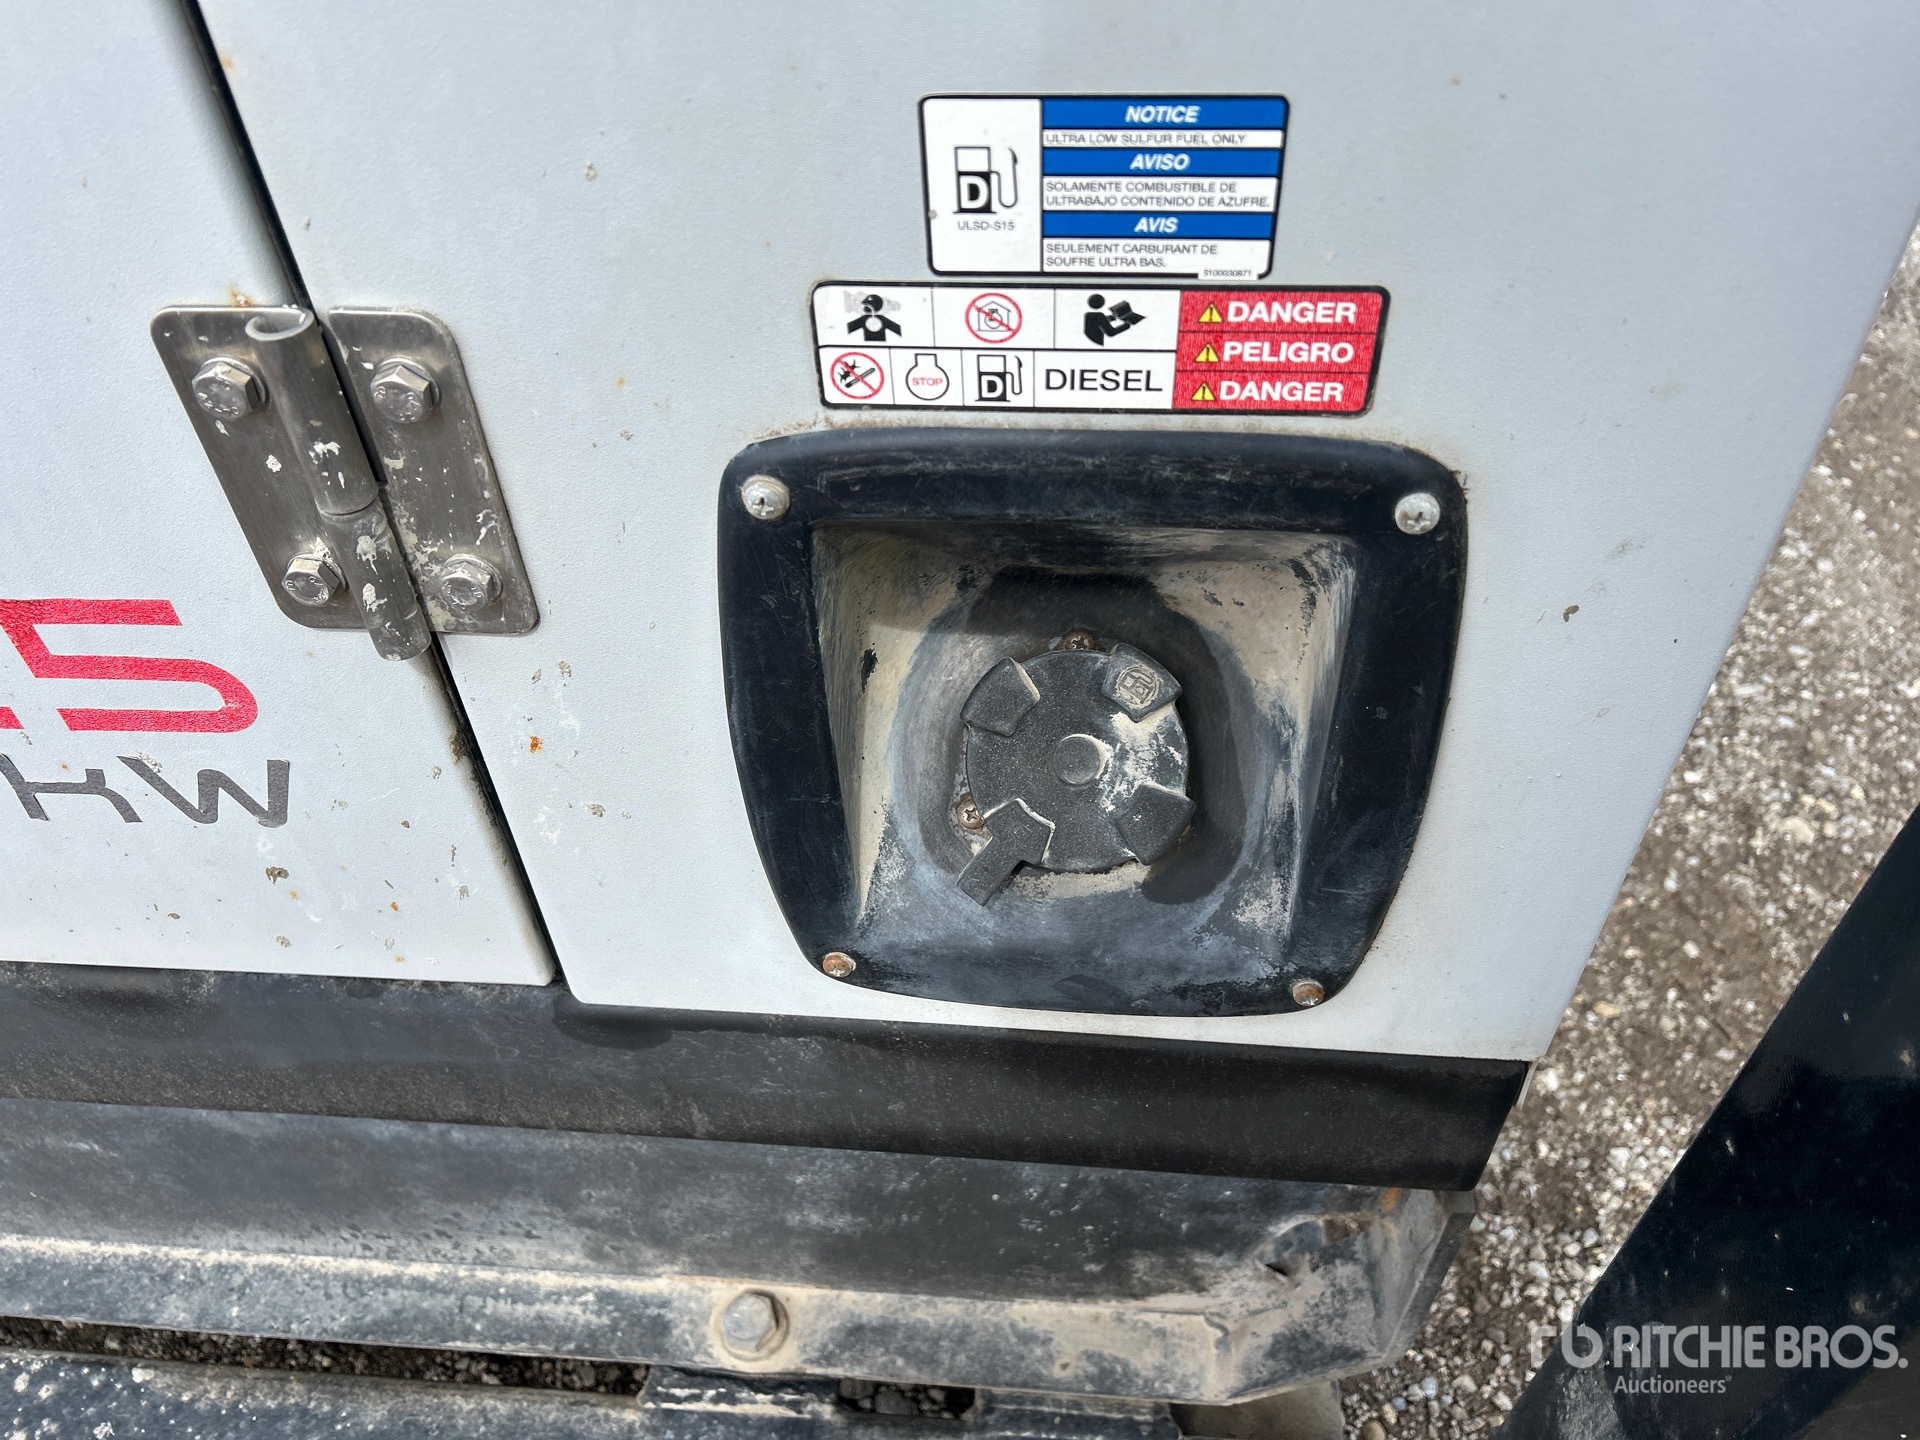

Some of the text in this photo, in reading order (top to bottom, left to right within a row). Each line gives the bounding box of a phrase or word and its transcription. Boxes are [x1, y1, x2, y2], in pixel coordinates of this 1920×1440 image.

[1125, 105, 1200, 123] NOTICE
[1045, 133, 1246, 144] ULTRA LOW SULFUR FUEL ONLY
[1129, 153, 1191, 171] AVISO
[1046, 181, 1237, 193] SOLAMENTE COMBUSTIBLE DE
[1046, 196, 1270, 208] ULTRABAJO CONTENIDO DE AZUFRE.
[957, 220, 1016, 231] ULSD-S15
[1134, 216, 1180, 234] AVIS
[1046, 243, 1218, 255] SEULEMENT CARBURANT DE
[1046, 257, 1166, 268] SOUFRE ULTRA BAS.
[1226, 301, 1358, 324] DANGER
[1222, 340, 1355, 364] PELIGRO
[911, 376, 943, 387] STOP
[1045, 368, 1163, 392] DIESEL
[1219, 380, 1344, 403] DANGER
[0, 598, 258, 733] 5
